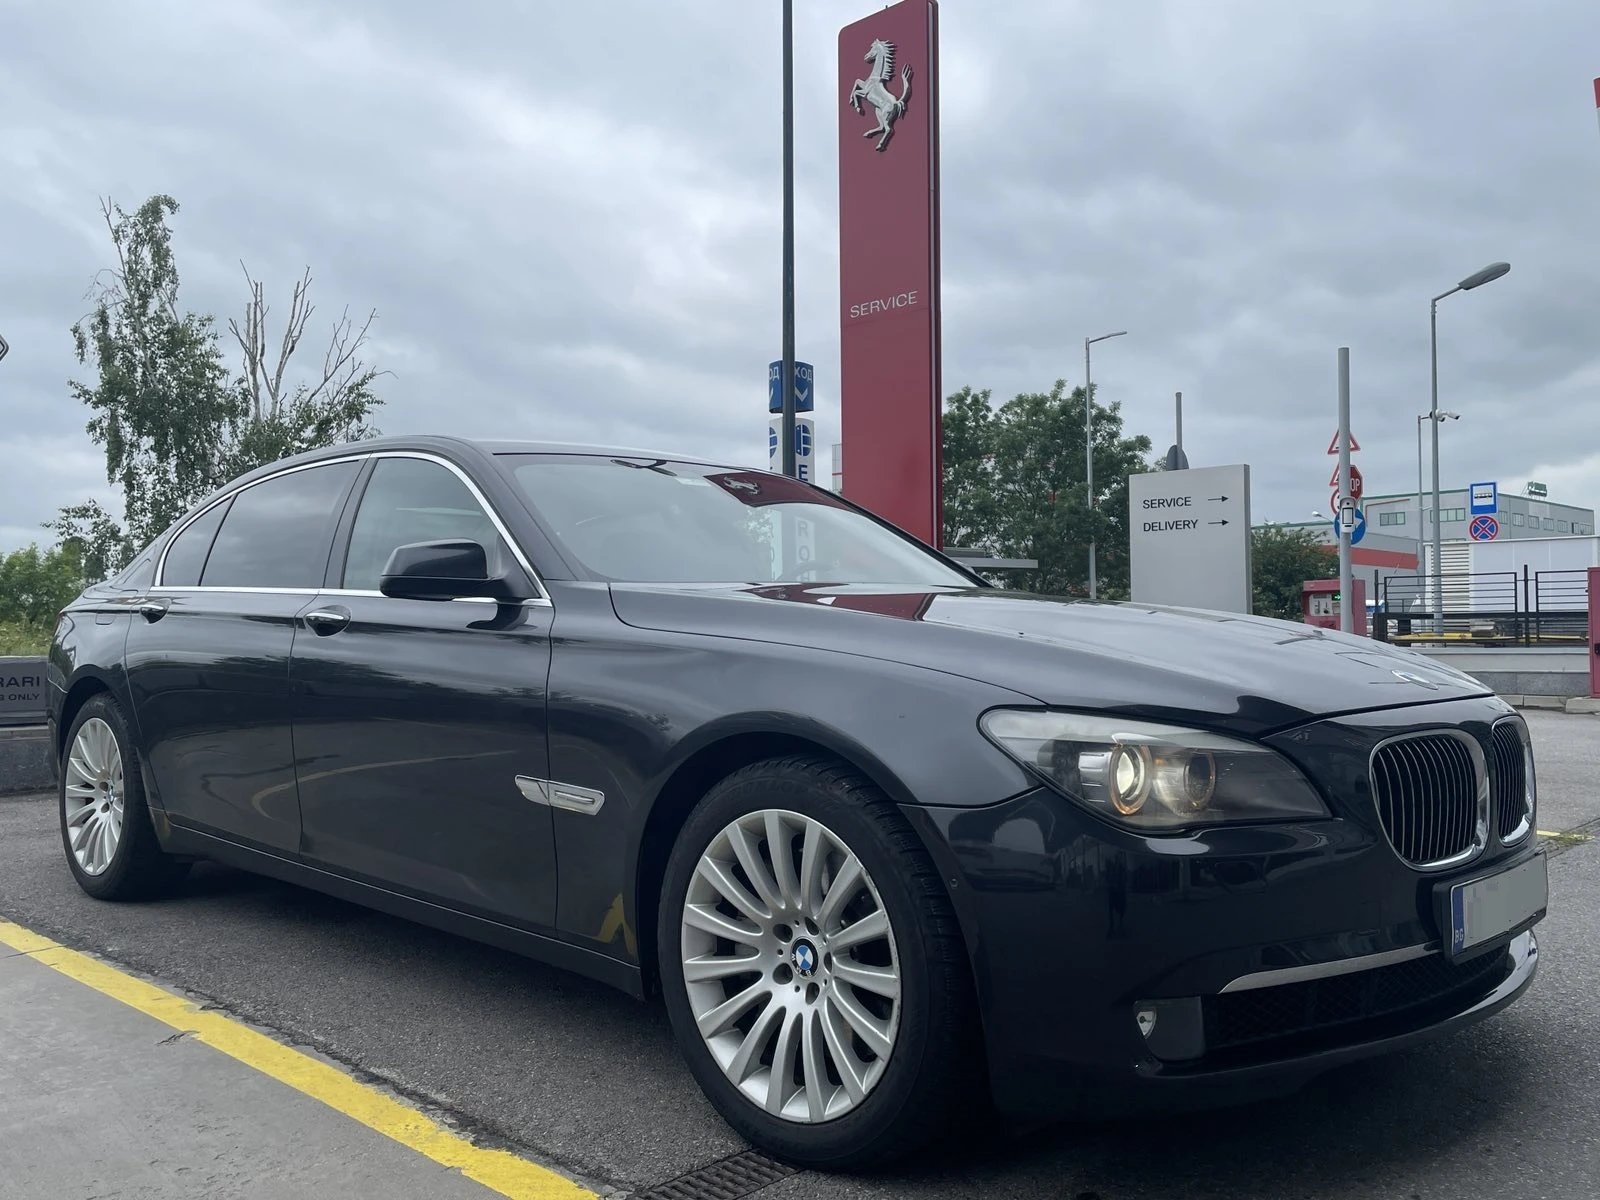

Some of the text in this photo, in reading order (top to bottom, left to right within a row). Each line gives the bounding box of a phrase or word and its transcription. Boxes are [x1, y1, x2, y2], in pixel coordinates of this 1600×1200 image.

[850, 291, 918, 318] SERVICE
[1350, 478, 1360, 492] OP
[1142, 496, 1192, 509] SERVICE
[1143, 519, 1199, 532] DELIVERY
[8, 693, 40, 701] ONLY
[1455, 928, 1464, 944] BG
